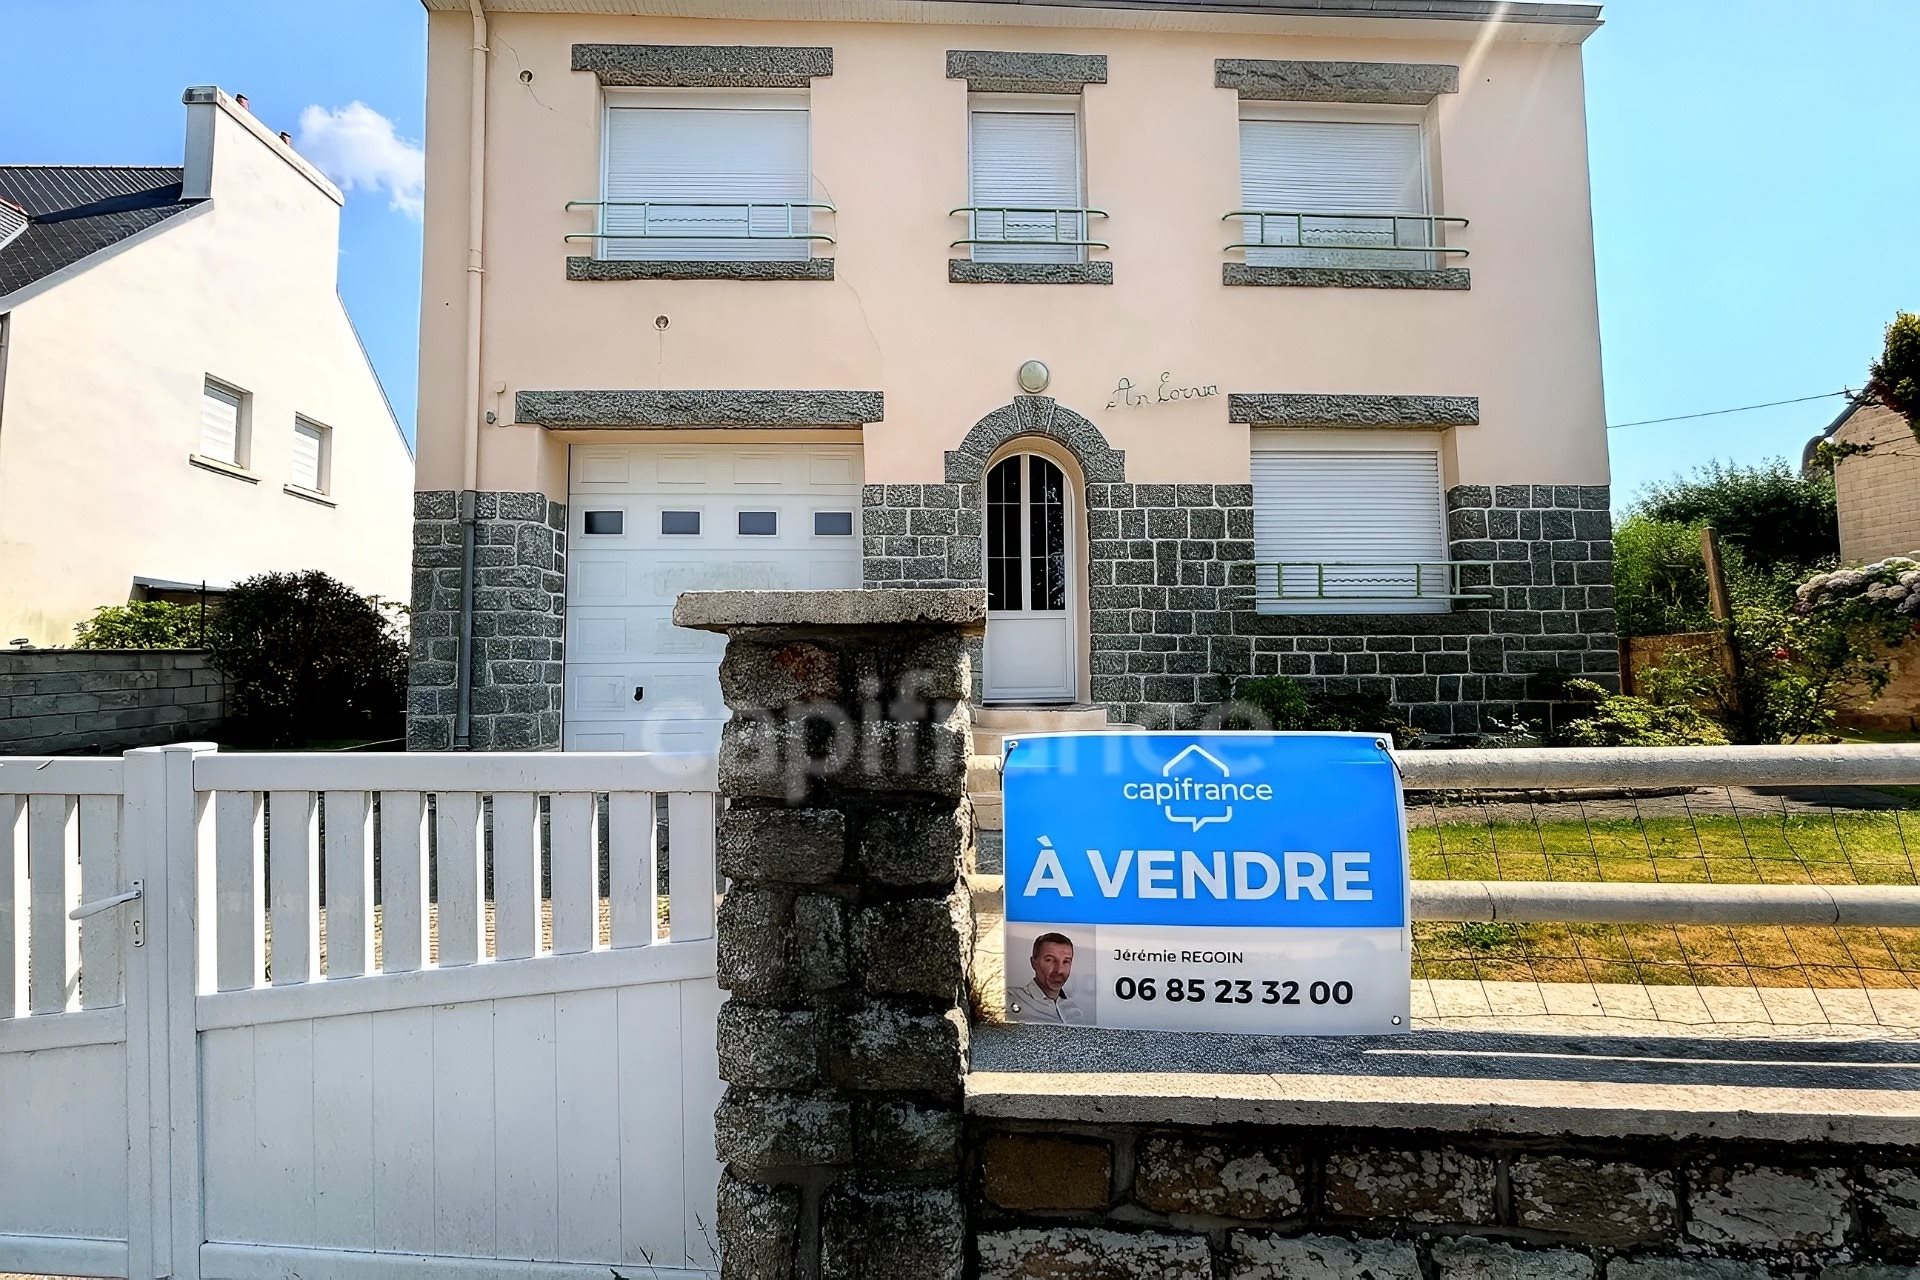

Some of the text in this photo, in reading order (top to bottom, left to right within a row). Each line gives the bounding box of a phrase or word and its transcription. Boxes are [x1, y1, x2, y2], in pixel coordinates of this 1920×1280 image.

[1106, 377, 1150, 409] An
[1123, 777, 1273, 805] capifrance
[1023, 835, 1373, 901] À VENDRE
[1114, 948, 1243, 964] Jérémie REGOIN
[1115, 976, 1353, 1005] 06 85 23 32 00
